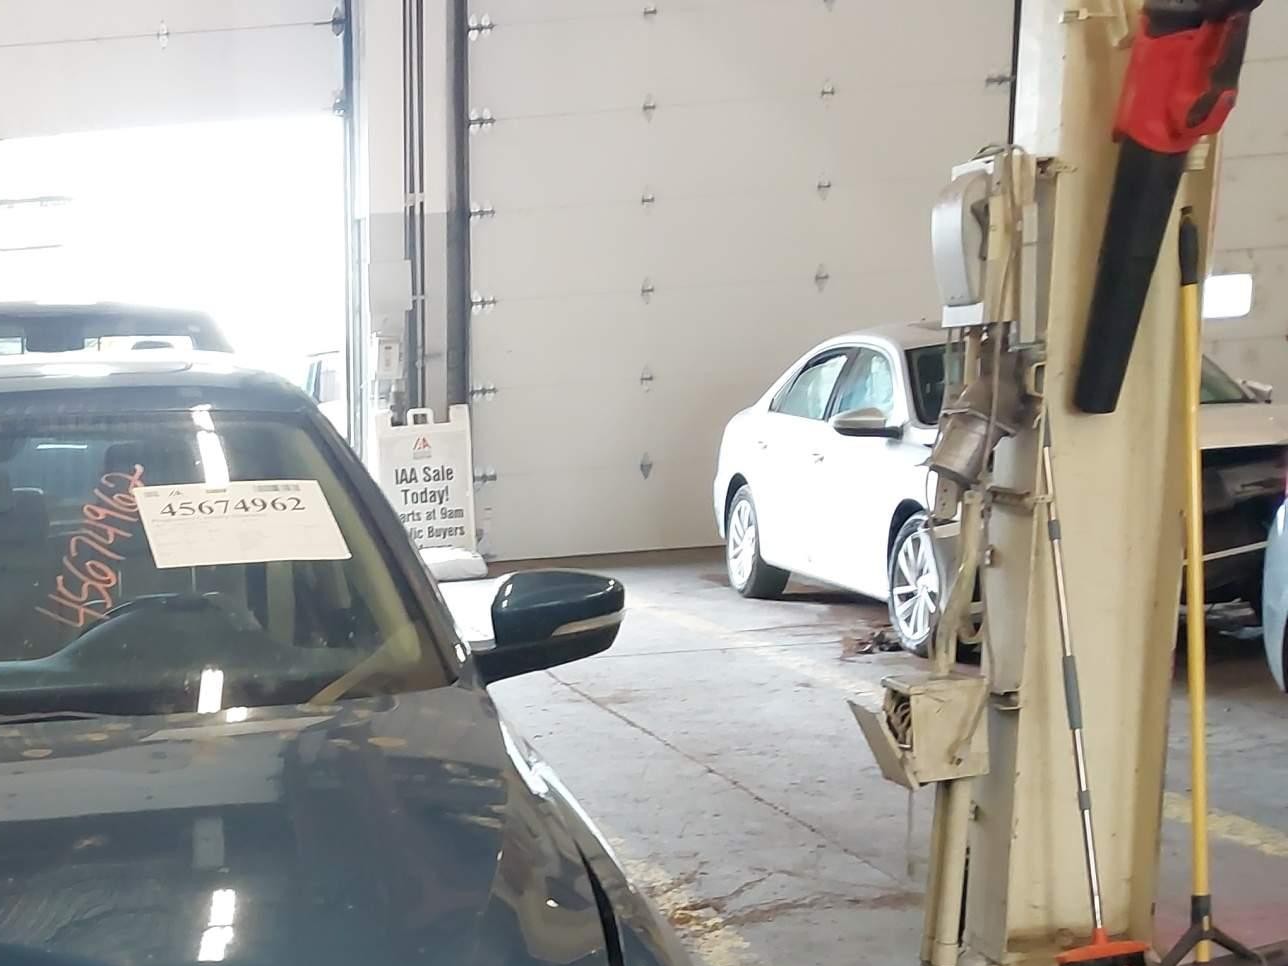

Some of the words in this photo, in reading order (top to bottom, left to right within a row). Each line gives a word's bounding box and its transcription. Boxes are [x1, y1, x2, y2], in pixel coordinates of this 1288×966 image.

[395, 467, 418, 485] IAA
[423, 465, 454, 483] Sale
[401, 486, 449, 505] Today!
[160, 496, 306, 516] 45674962
[400, 510, 422, 523] arts
[425, 509, 436, 521] at
[440, 507, 464, 519] 9am
[427, 525, 465, 539] Buyers
[35, 463, 145, 627] 45674962
